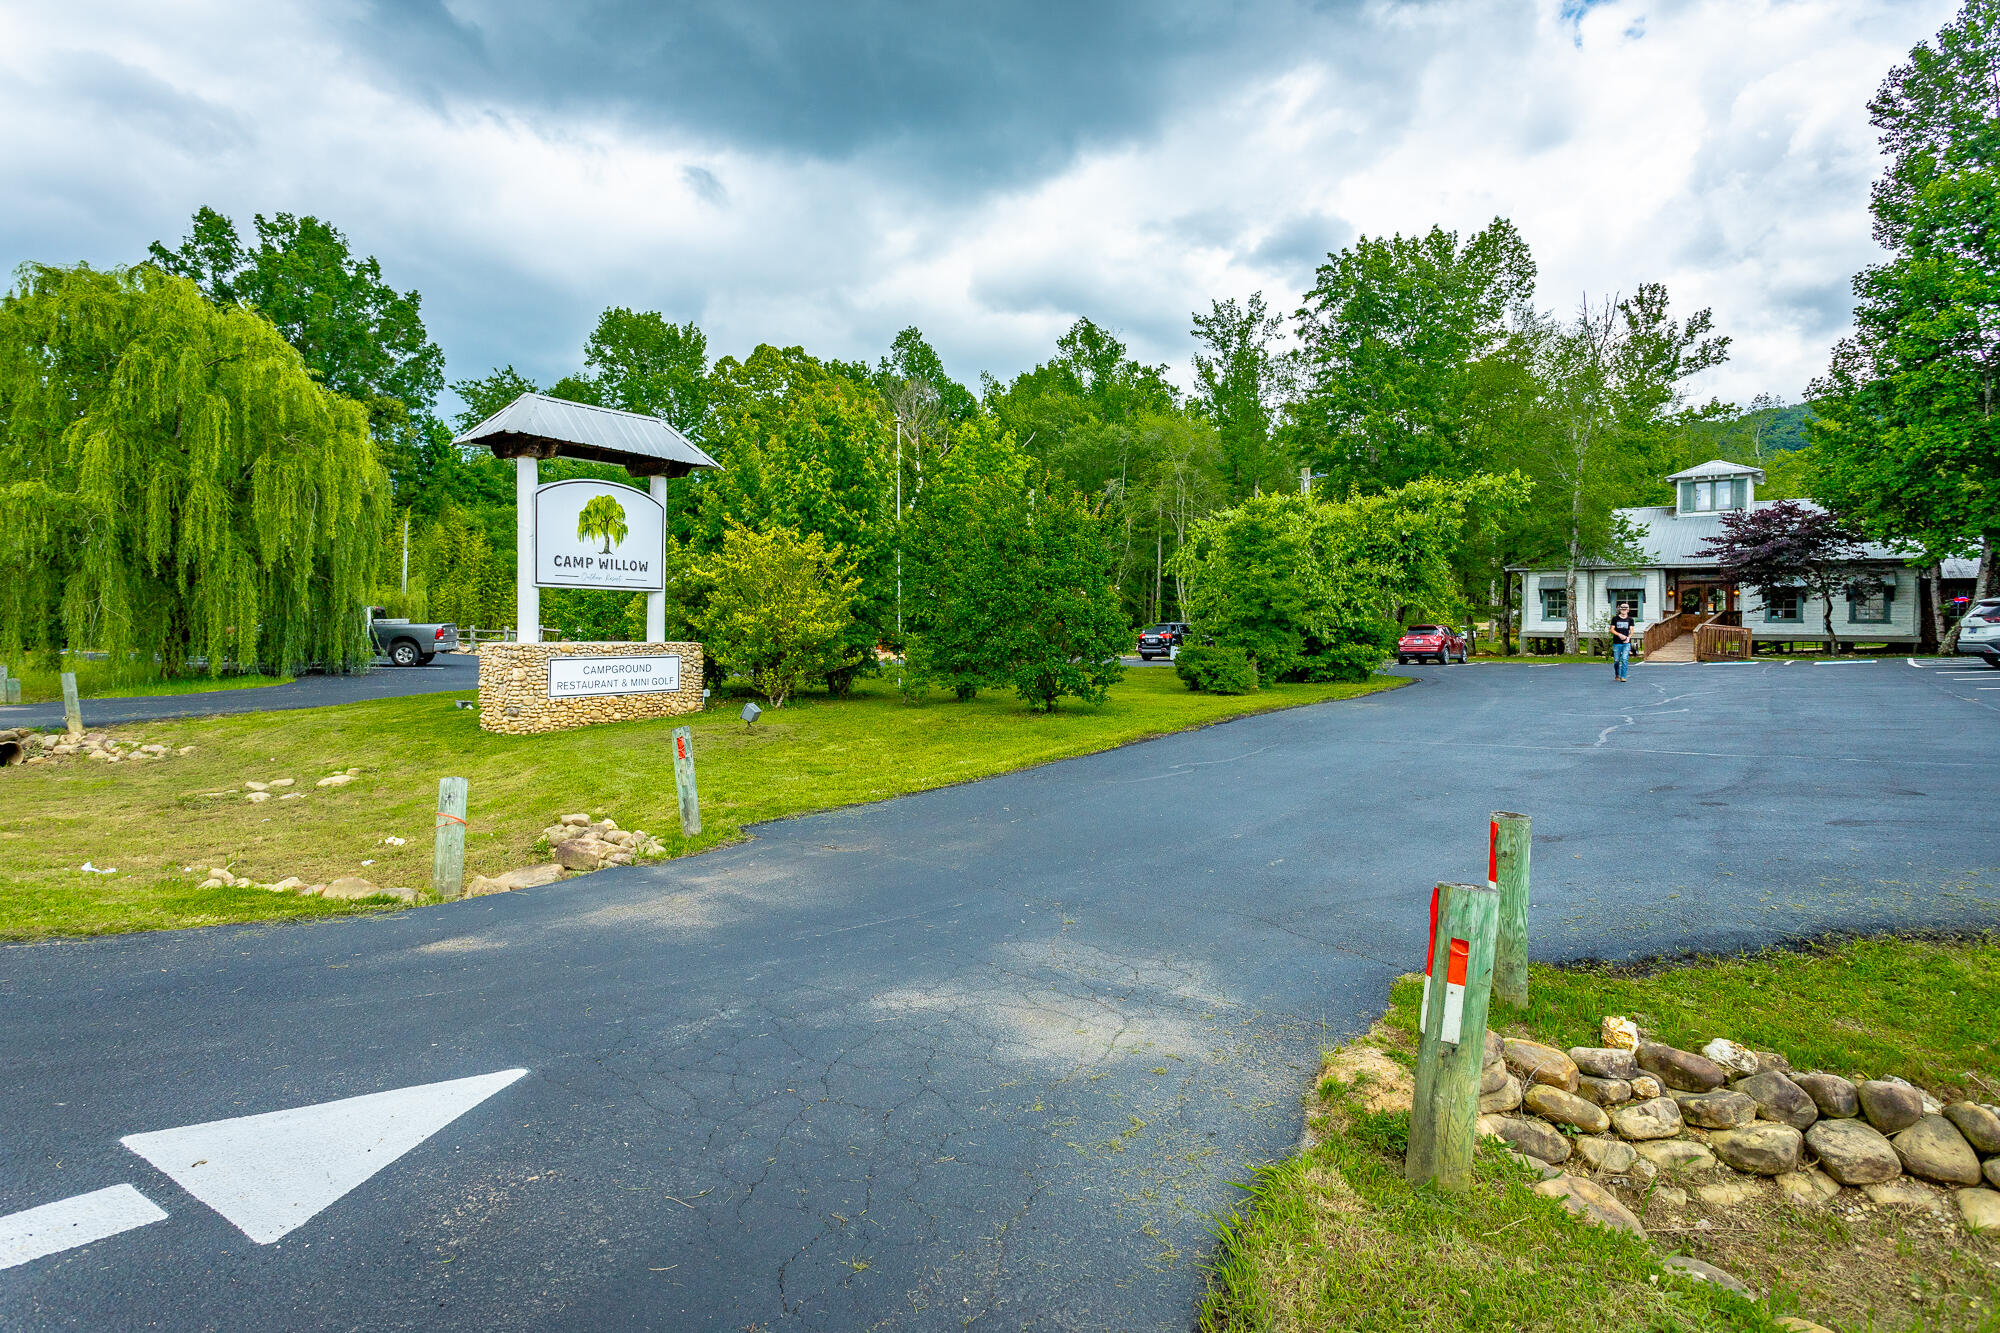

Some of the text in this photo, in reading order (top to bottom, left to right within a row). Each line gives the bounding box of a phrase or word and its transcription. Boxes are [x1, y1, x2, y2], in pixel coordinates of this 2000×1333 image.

[554, 555, 648, 572] CAMP WILLOW
[583, 664, 652, 675] CAMPGROUND
[557, 676, 675, 691] RESTAURANT & MINI GOLF
